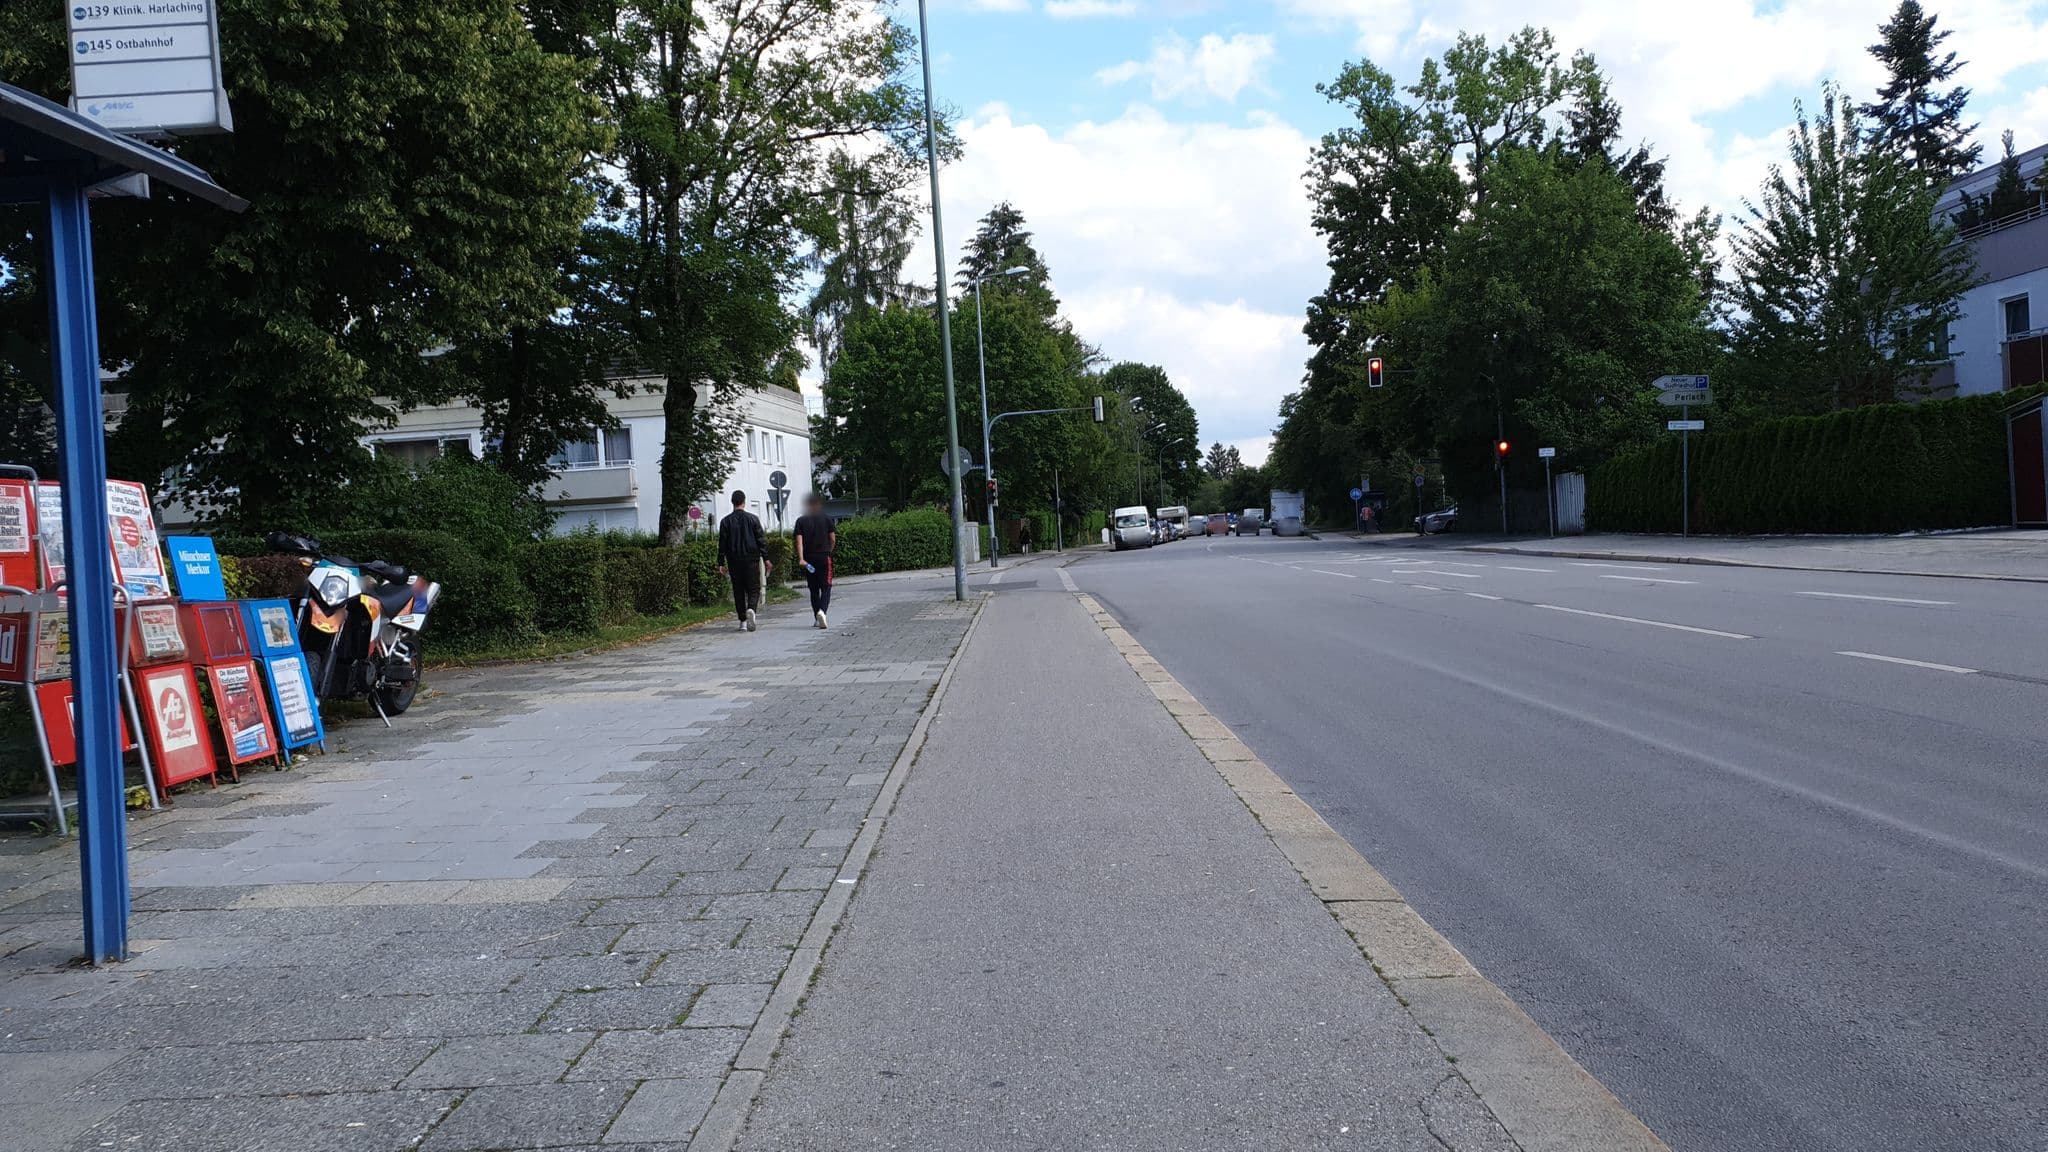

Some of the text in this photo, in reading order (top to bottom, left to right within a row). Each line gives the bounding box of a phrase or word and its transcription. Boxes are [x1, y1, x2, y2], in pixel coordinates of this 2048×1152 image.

[87, 6, 109, 17] 139
[149, 2, 203, 14] Harlaching
[90, 39, 112, 51] 145
[116, 36, 174, 49] Ostbahnhof
[1674, 392, 1706, 400] Perlach
[178, 550, 211, 561] Münchner
[185, 562, 210, 575] Merkur
